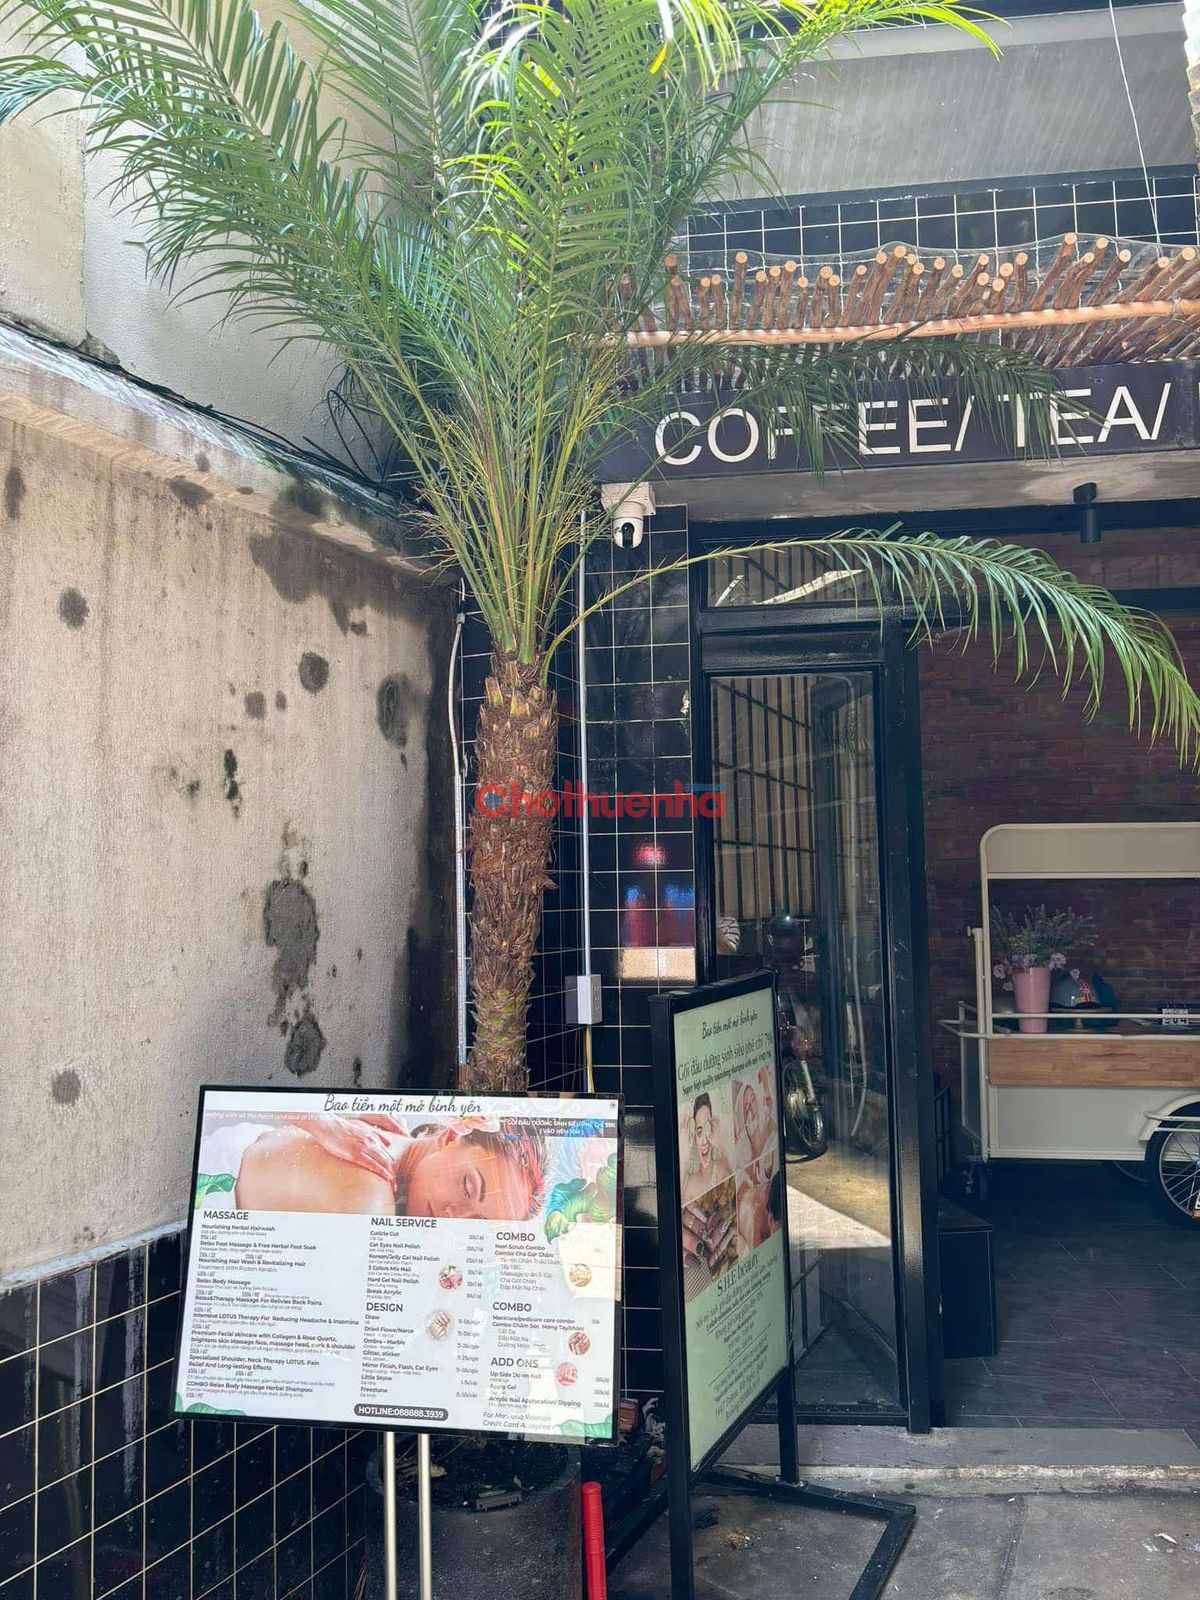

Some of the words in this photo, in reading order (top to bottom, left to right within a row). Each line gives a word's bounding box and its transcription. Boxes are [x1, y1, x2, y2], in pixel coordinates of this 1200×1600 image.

[998, 382, 1172, 448] TEA/
[324, 1094, 347, 1112] Bao
[460, 1100, 482, 1118] yên
[203, 1210, 249, 1220] MASSAGE
[371, 1217, 394, 1226] NAIL
[395, 1218, 437, 1228] SERVICE
[496, 1232, 535, 1241] COMBO
[366, 1302, 403, 1312] DESIGN
[492, 1302, 532, 1311] COMBO
[490, 1357, 514, 1367] ADD
[516, 1358, 539, 1368] ONS
